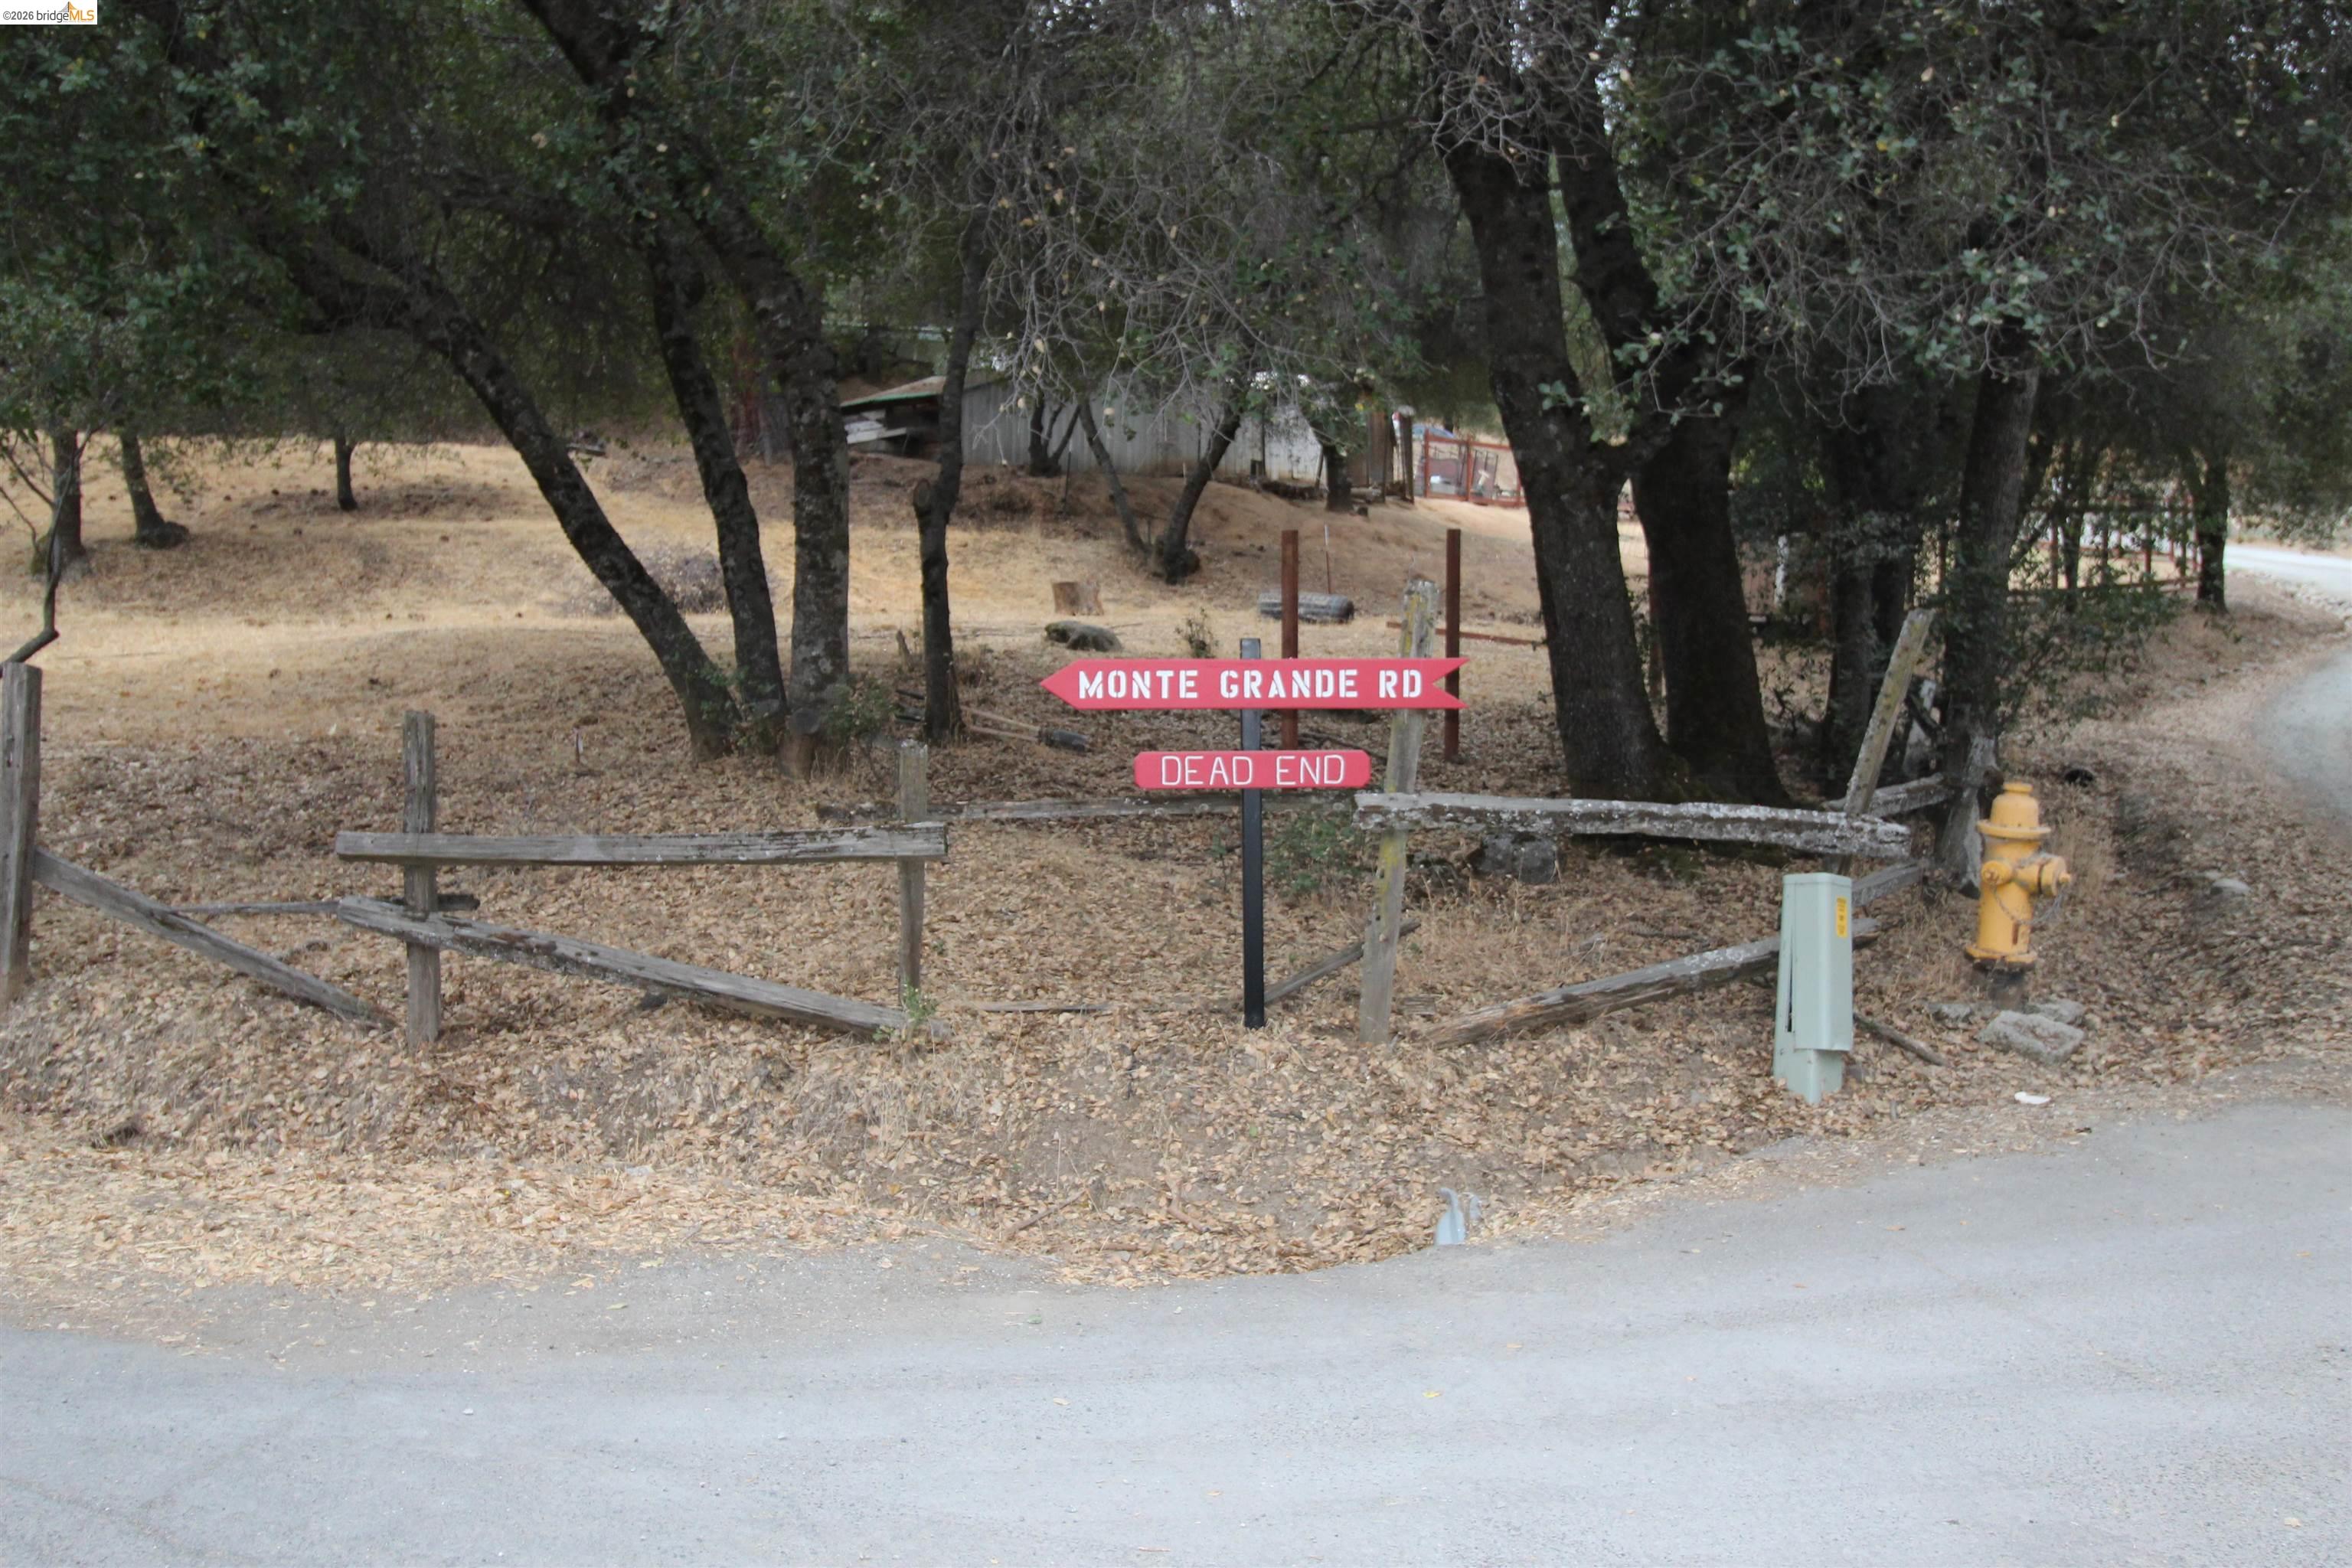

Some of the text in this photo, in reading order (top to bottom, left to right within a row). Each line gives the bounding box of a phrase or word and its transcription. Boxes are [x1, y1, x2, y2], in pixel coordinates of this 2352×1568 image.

[1078, 668, 1423, 699] MONTE GRANDE RD
[1161, 754, 1345, 786] DEAD END
